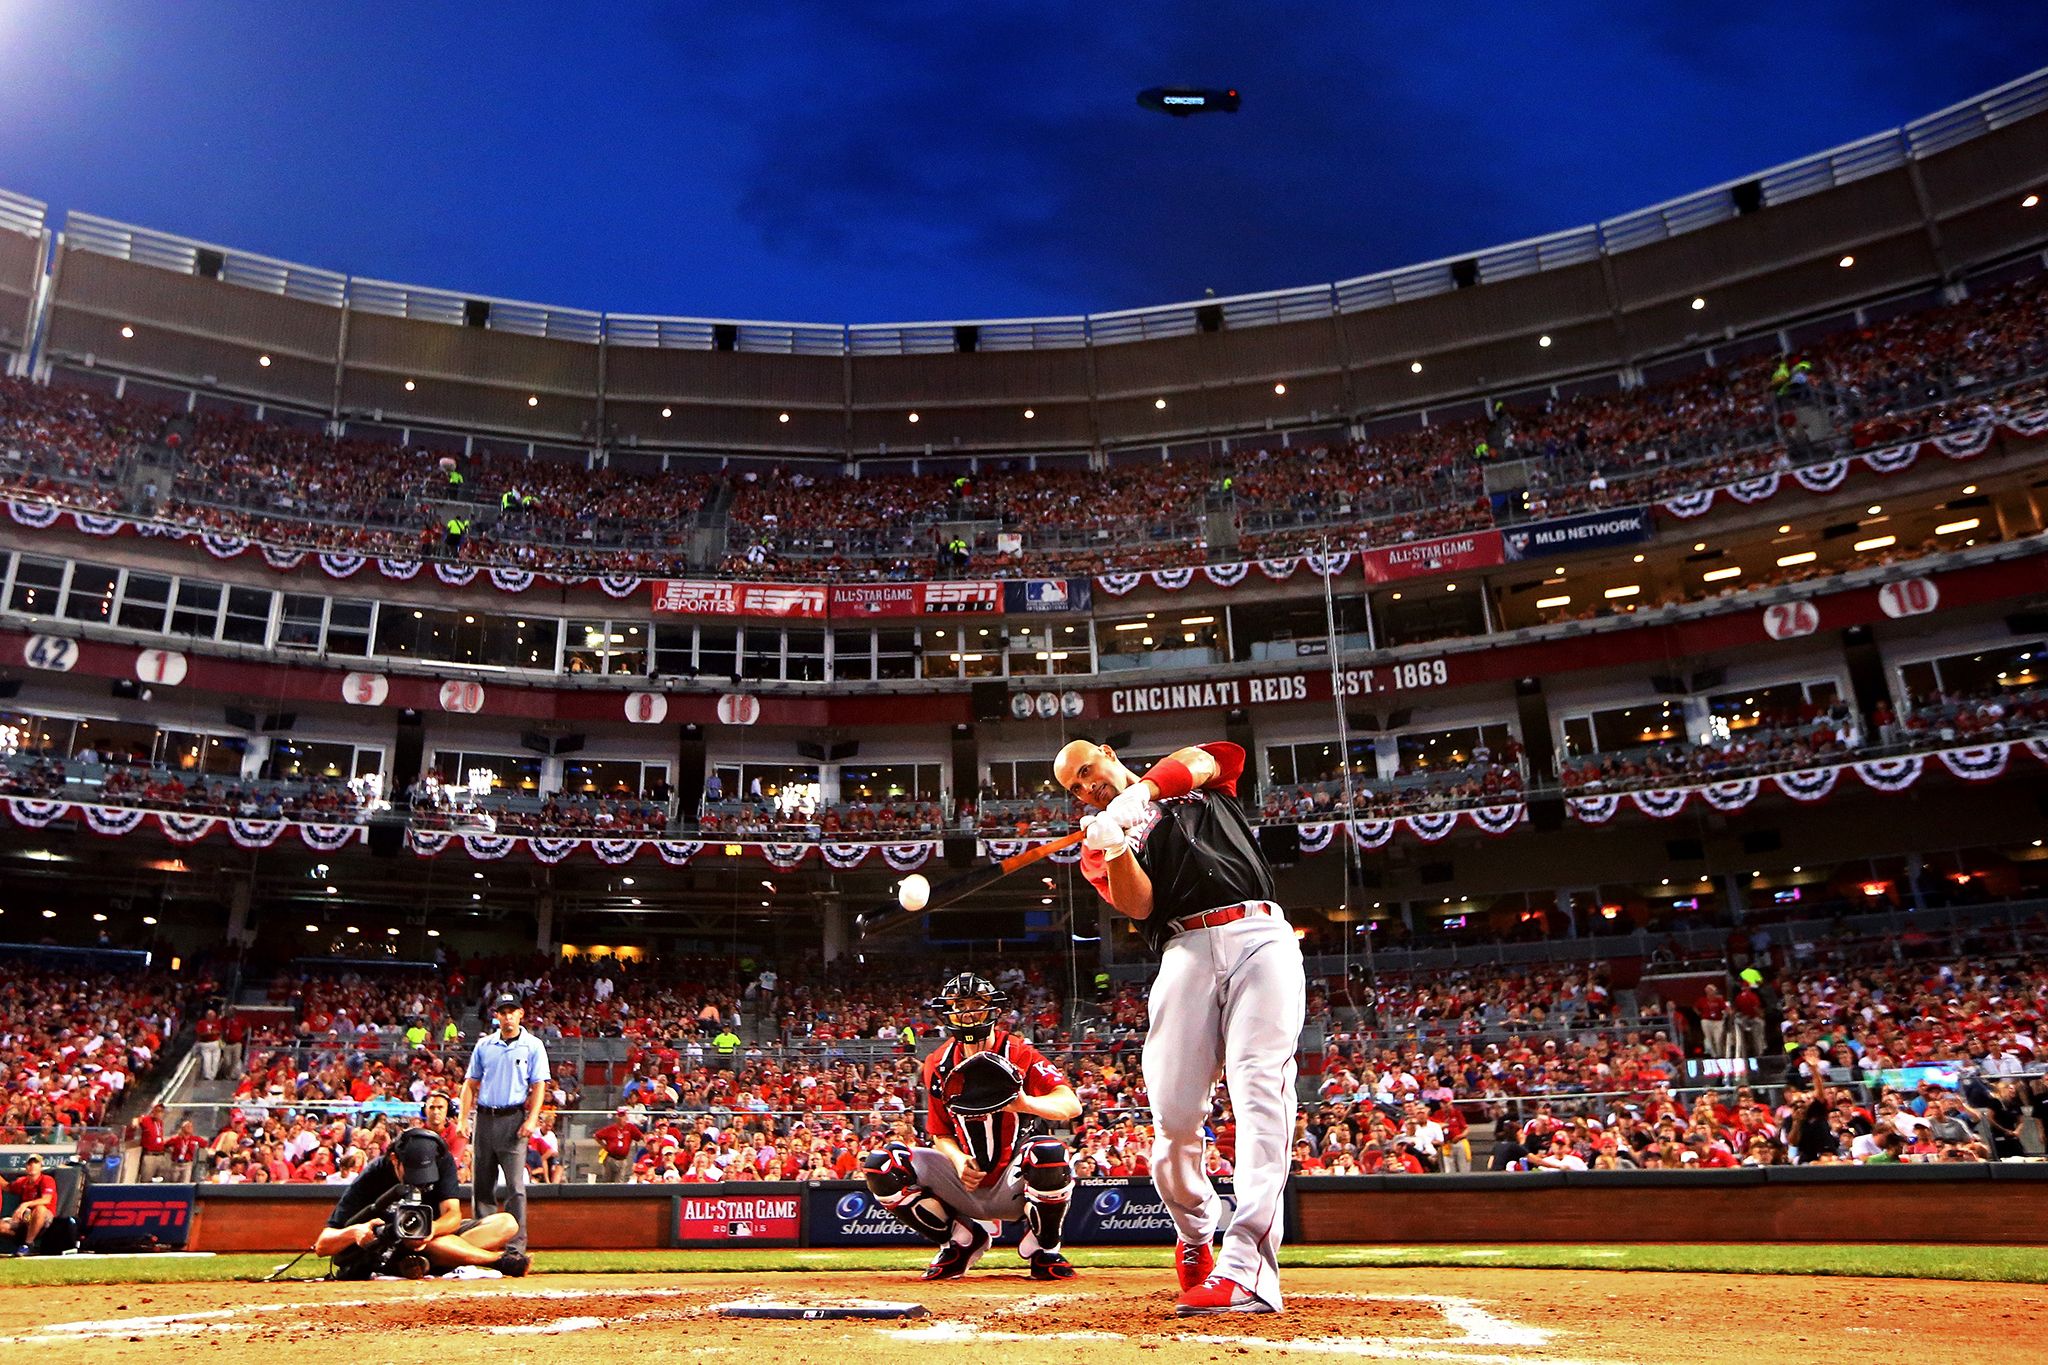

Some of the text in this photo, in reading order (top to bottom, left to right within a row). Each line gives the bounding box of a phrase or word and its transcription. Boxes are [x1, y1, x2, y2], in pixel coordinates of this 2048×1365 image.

[1535, 518, 1641, 545] MLB NETWORK
[1442, 539, 1475, 555] GAME
[666, 582, 733, 599] ESPN
[744, 589, 825, 612] ESPN
[883, 588, 912, 601] GAME
[925, 582, 998, 603] ESPN
[1888, 580, 1930, 614] 10
[657, 598, 735, 612] DEPORTES
[925, 602, 994, 612] RADIO
[30, 637, 70, 669] 42
[155, 650, 168, 682] 1
[357, 674, 375, 703] 5
[447, 683, 479, 711] 20
[1111, 659, 1448, 713] CINCINNATI REDS EST. 1869
[638, 693, 653, 721] 8
[1081, 1178, 1129, 1186] reds.com
[86, 1201, 188, 1227] ESPN
[756, 1200, 797, 1219] GAME
[1122, 1200, 1160, 1215] head
[1100, 1215, 1173, 1230] shoulders
